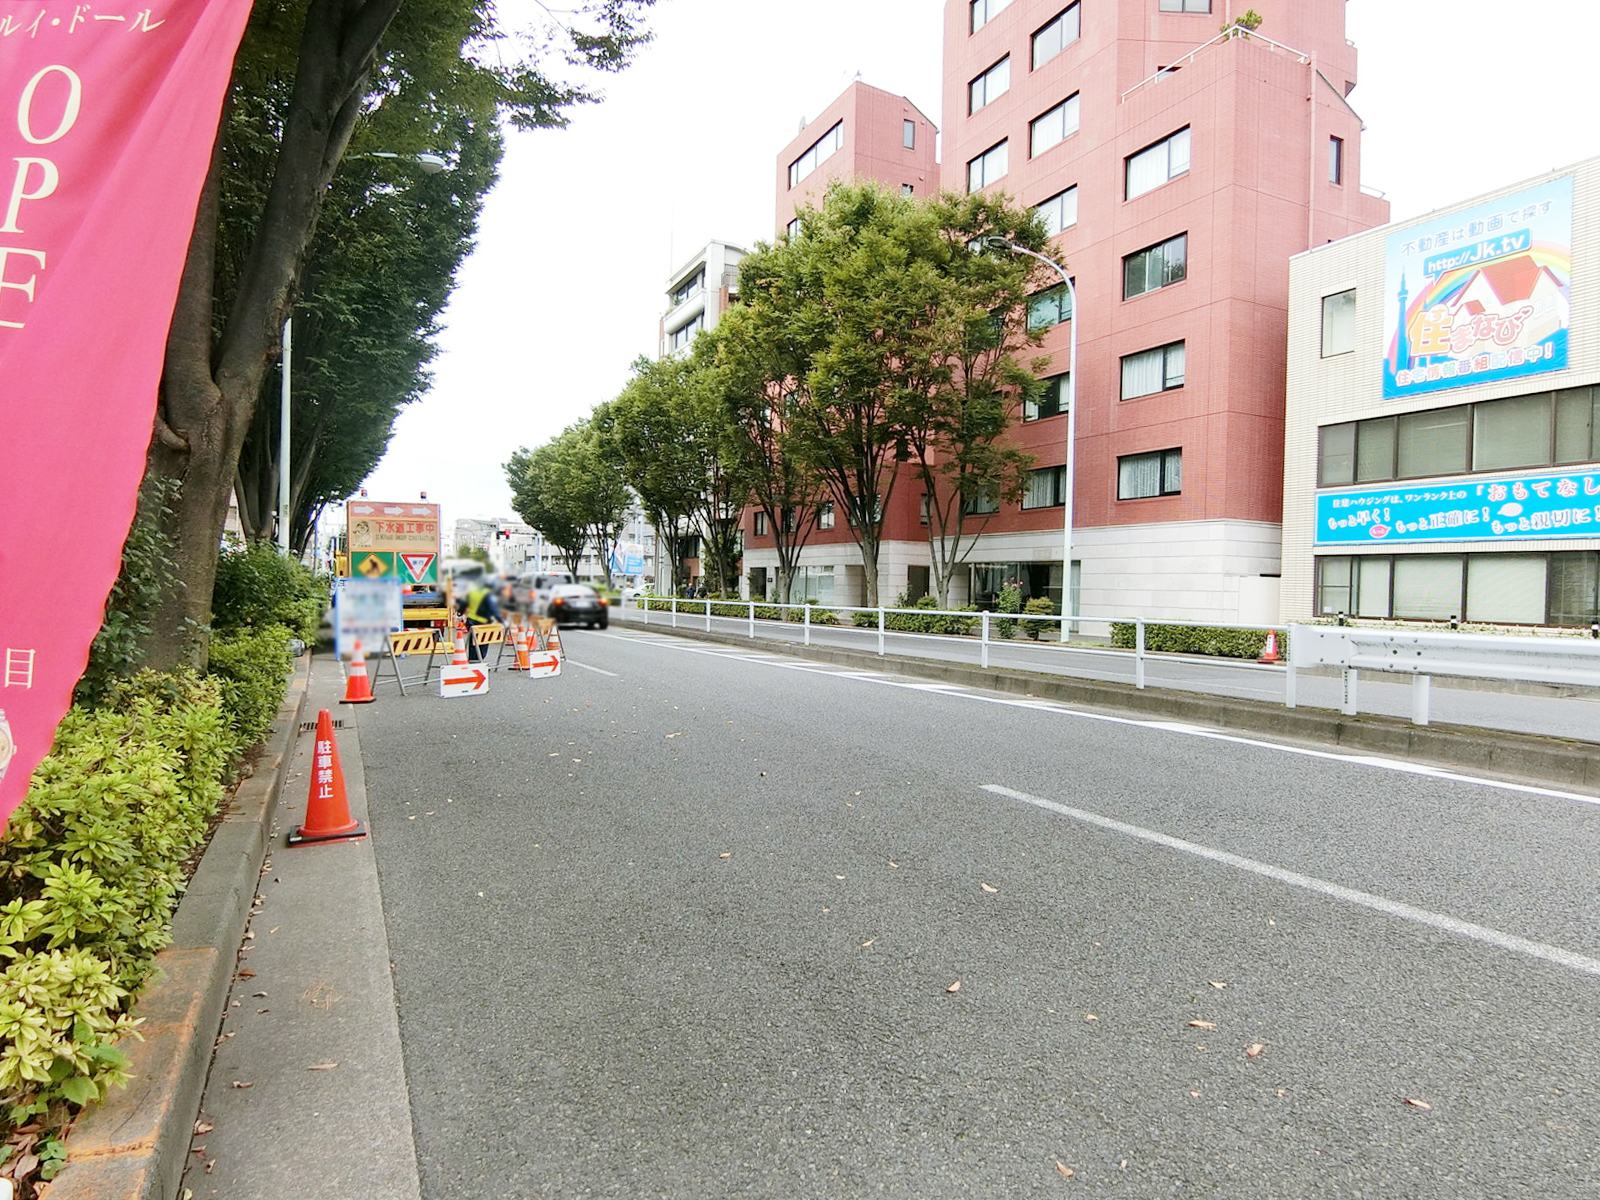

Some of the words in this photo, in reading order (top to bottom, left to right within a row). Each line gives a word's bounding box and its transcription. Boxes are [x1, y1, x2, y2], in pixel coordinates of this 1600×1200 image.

[1401, 200, 1553, 257] 不動産は動画で探す
[375, 521, 435, 535] 下水道工事中
[316, 740, 334, 799] 駐車禁止
